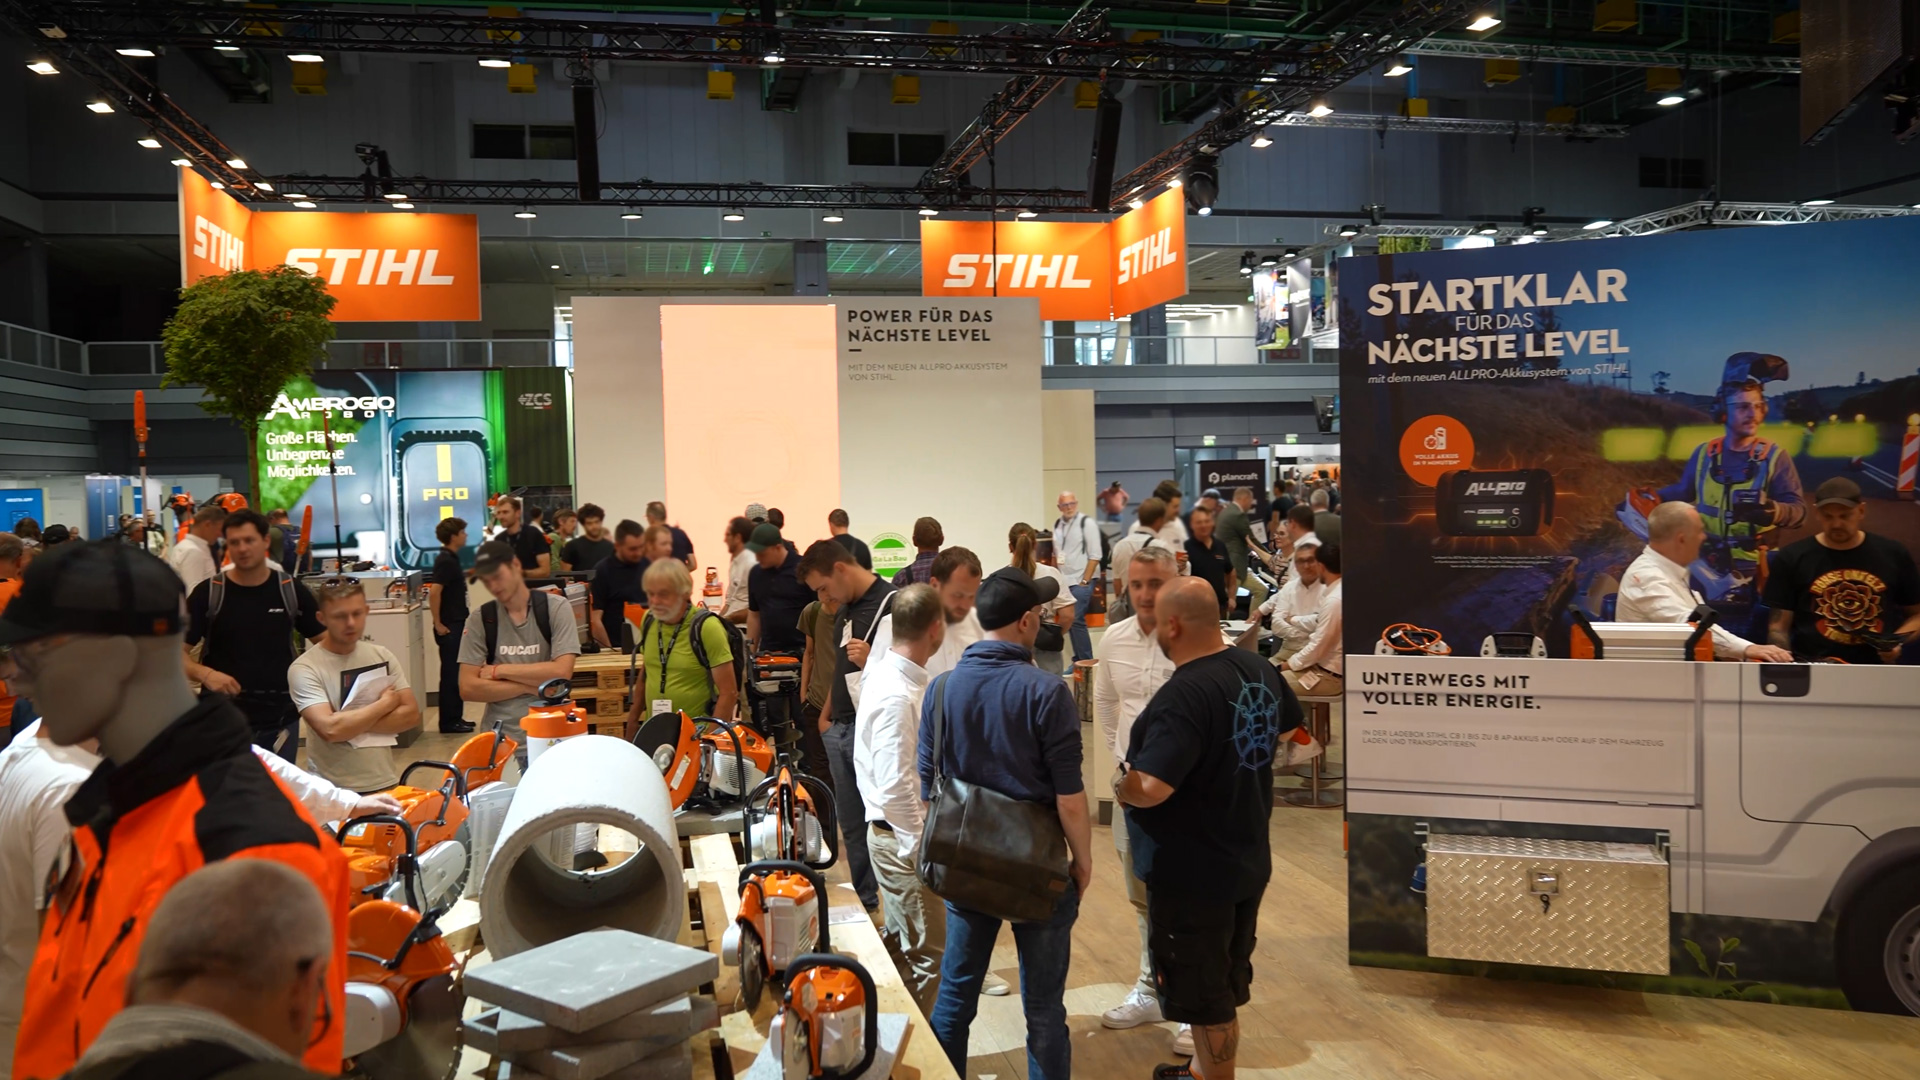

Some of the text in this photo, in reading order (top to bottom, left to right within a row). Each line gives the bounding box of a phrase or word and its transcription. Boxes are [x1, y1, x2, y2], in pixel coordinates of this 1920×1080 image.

[1118, 227, 1177, 285] STIHL
[285, 248, 455, 286] STIHL
[943, 254, 1092, 288] STIHL
[1366, 268, 1628, 317] STARTKLAR
[848, 307, 993, 323] POWER FÜR DAS
[1455, 312, 1534, 332] FÜR DAS
[848, 326, 991, 342] NÄCHSTE LEVEL
[1368, 329, 1630, 365] NÄCHSTE LEVEL
[848, 363, 863, 371] MIT
[866, 363, 885, 371] DEM
[888, 363, 917, 371] NEUEN
[1368, 363, 1629, 384] mit dem neuen ALLPRO-Akkusystem von STIHL
[848, 373, 897, 381] VON STIHL.
[264, 393, 395, 420] AMBROGIO
[524, 393, 553, 406] ZCS
[300, 410, 395, 420] ROBOT
[265, 430, 358, 445] Große Flähen.
[1221, 472, 1259, 483] plancraft
[423, 487, 469, 501] PRO
[500, 643, 540, 656] DUCATI
[1362, 672, 1530, 689] UNTERWEGS MIT
[1362, 691, 1541, 710] VOLLER ENERGIE.
[1389, 730, 1424, 738] LADEBOX
[1426, 731, 1448, 739] STIHL
[1556, 736, 1580, 744] ODER
[1619, 739, 1665, 747] FAHRZEUG
